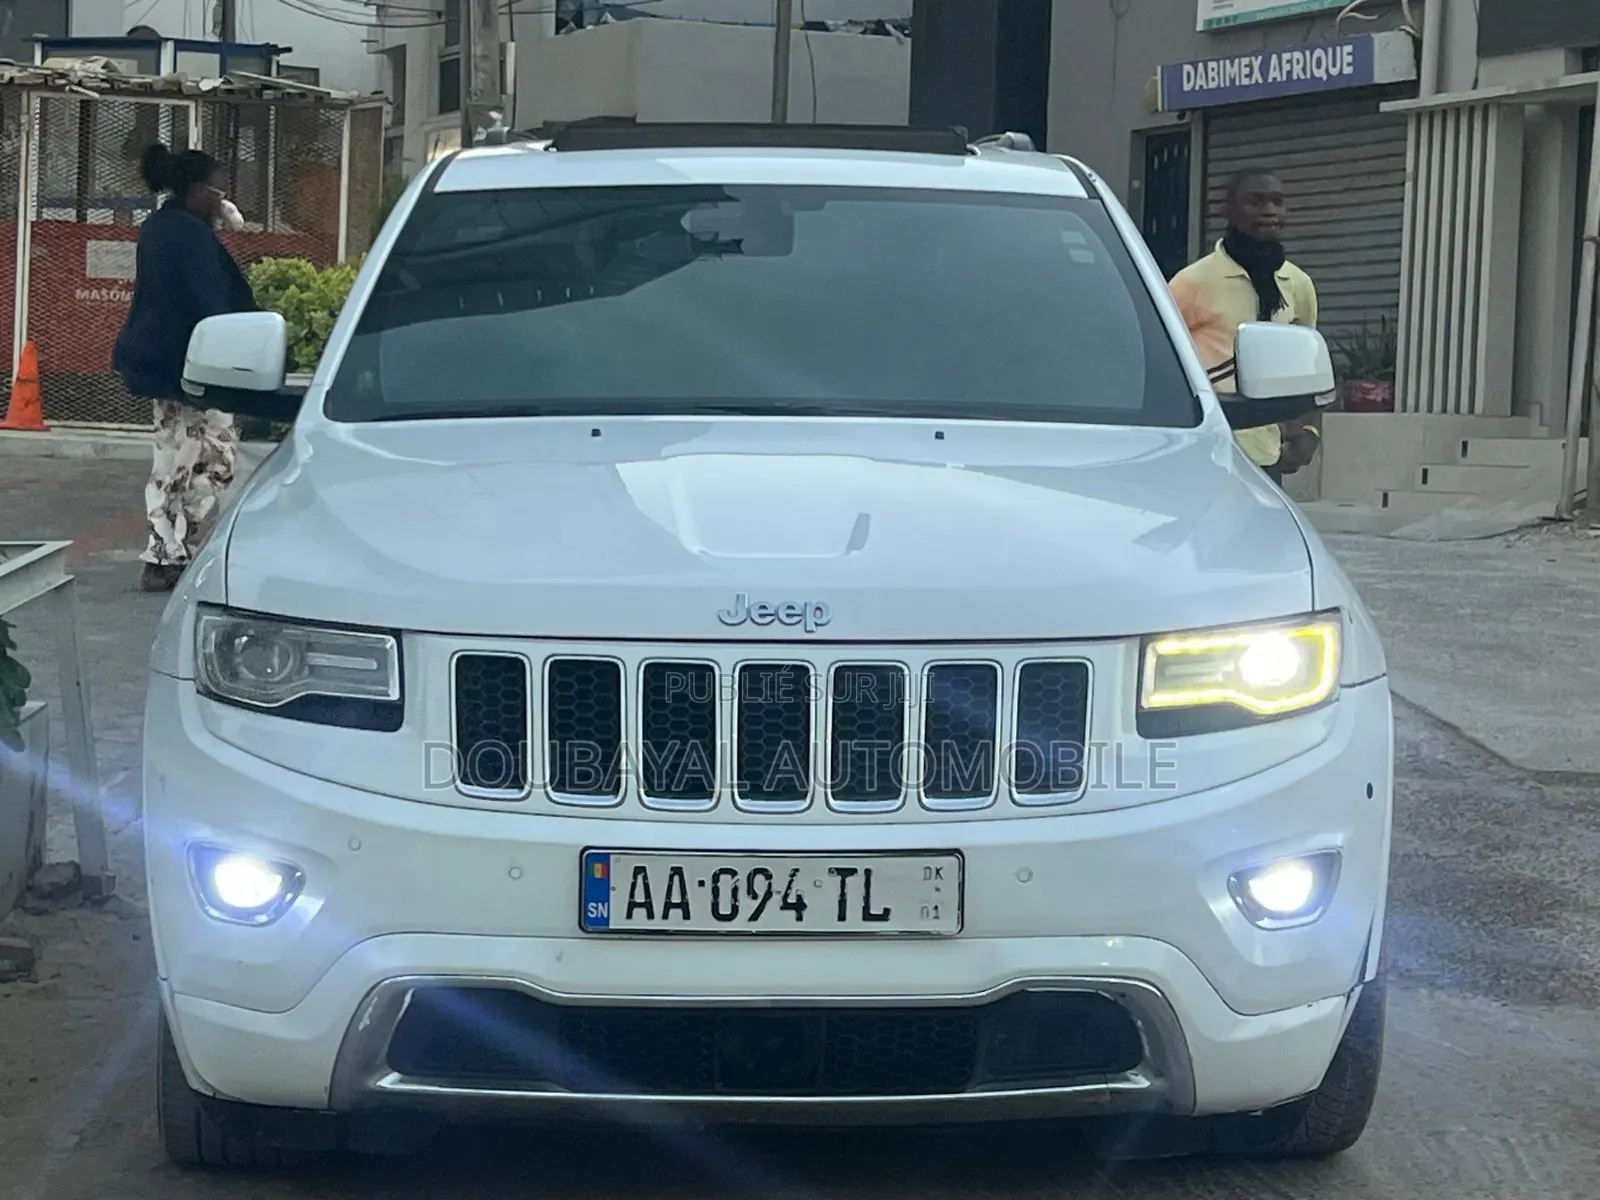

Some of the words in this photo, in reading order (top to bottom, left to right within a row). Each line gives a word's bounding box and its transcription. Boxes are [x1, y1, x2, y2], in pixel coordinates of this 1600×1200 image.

[1182, 55, 1263, 92] DABIMEX
[1267, 44, 1354, 82] AFRIQUE
[717, 592, 832, 634] Jeep
[923, 865, 944, 881] DK
[587, 902, 609, 919] SN
